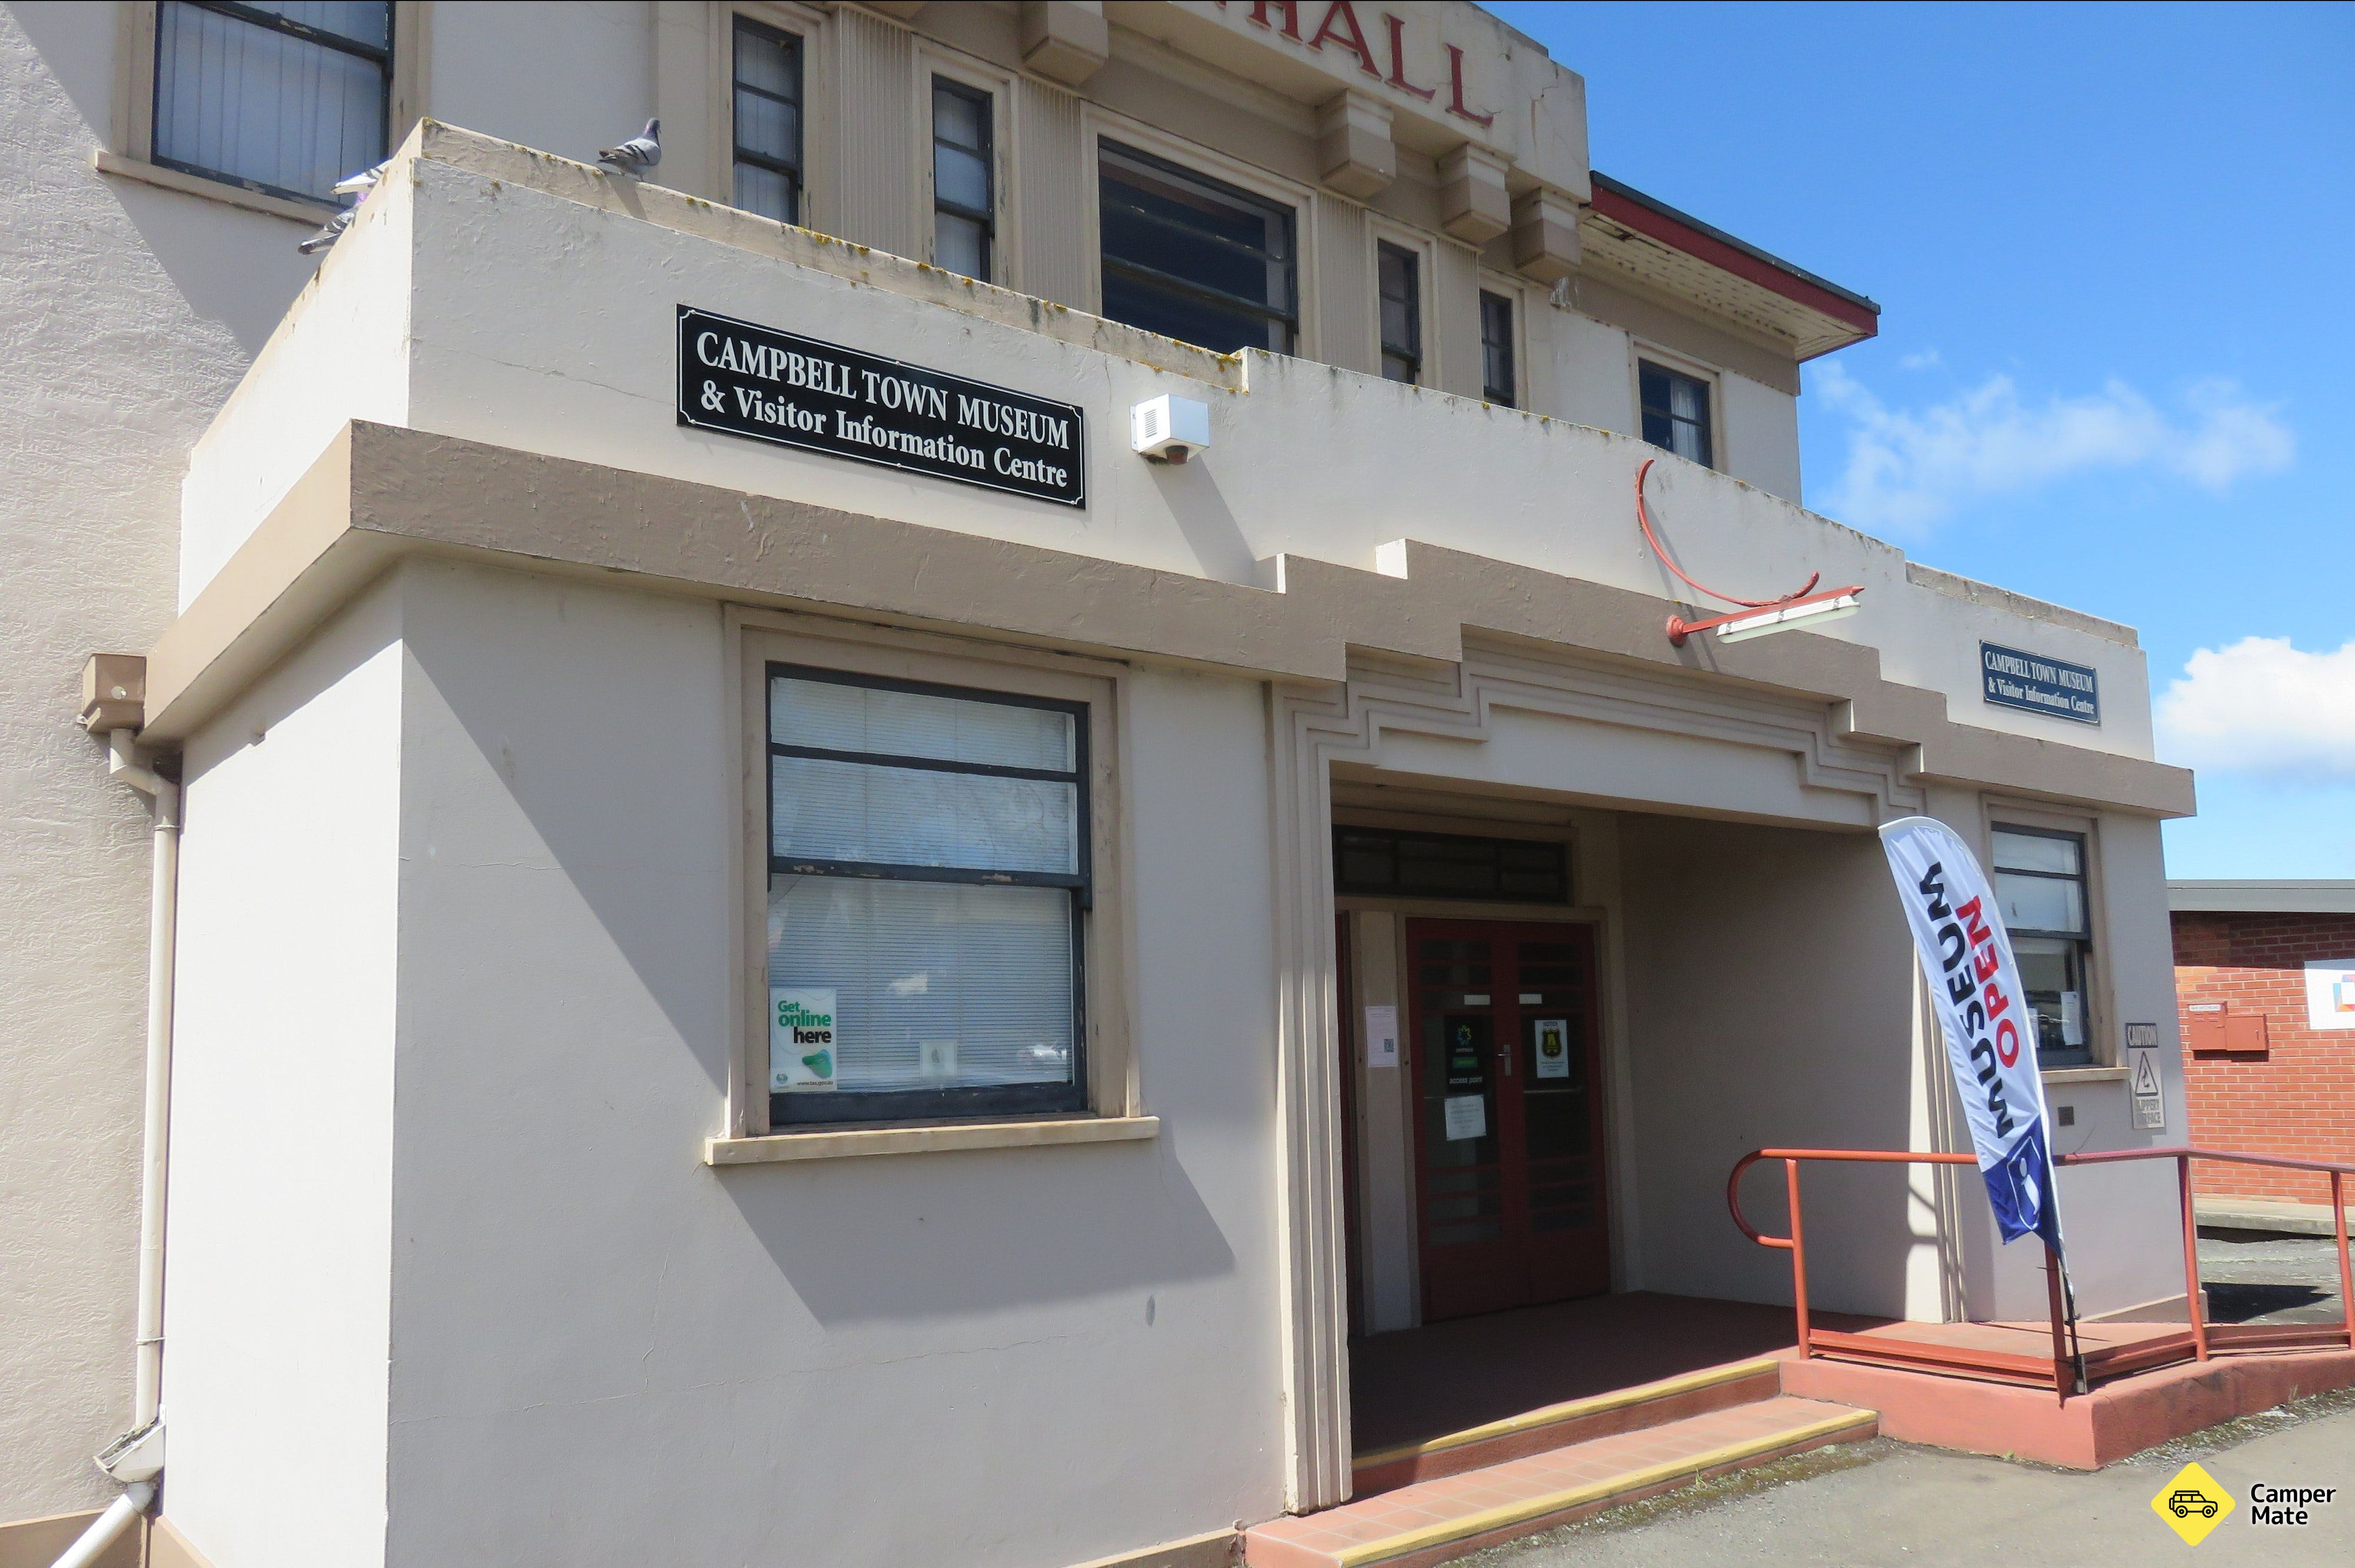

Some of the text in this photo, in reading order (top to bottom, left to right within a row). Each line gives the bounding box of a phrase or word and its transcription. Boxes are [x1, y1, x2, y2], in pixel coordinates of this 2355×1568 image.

[697, 331, 1069, 450] CAMPBELL TOWN MUSEUM
[701, 380, 1067, 487] & Visitor Information Centre
[1985, 651, 2094, 693] CAMPBELL TOWN MUSEUM
[1988, 676, 2094, 715] & Visitor Information Centre
[1919, 861, 2014, 1138] MUSEUM
[1956, 895, 2019, 1068] OPEN
[778, 1001, 800, 1012] Get
[778, 1009, 831, 1026] online
[794, 1026, 832, 1044] here
